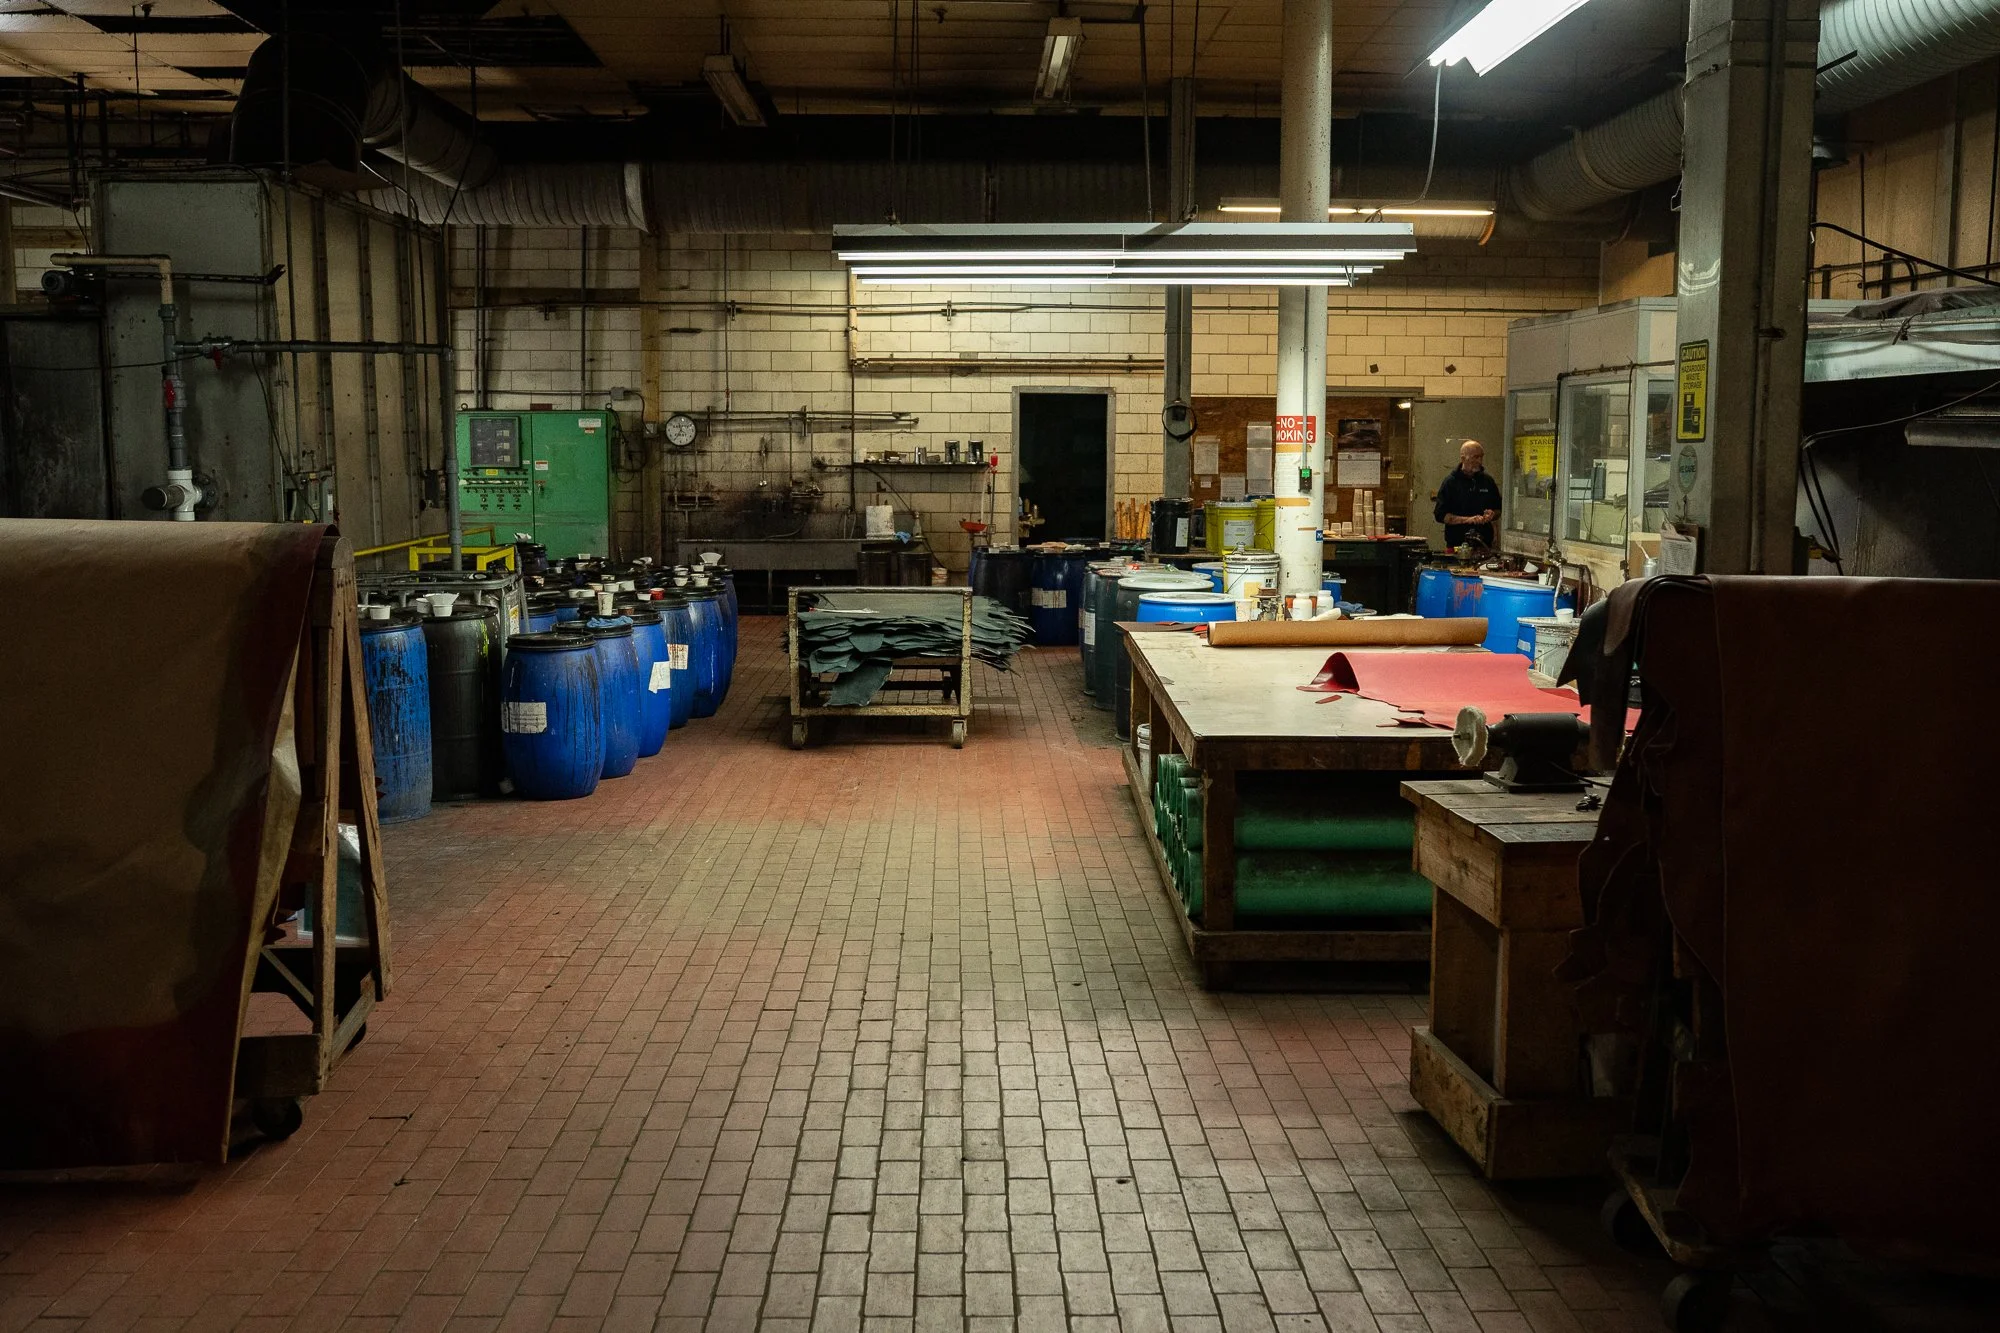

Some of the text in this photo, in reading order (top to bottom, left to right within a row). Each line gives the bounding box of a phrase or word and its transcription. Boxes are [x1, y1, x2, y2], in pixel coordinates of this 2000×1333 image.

[1682, 347, 1706, 360] CAUTION
[1681, 364, 1706, 373] HAZARDOUS
[1685, 373, 1701, 381] WASTE
[1683, 381, 1702, 390] STORAGE
[1280, 417, 1295, 429] NO
[1276, 430, 1314, 441] MOKING
